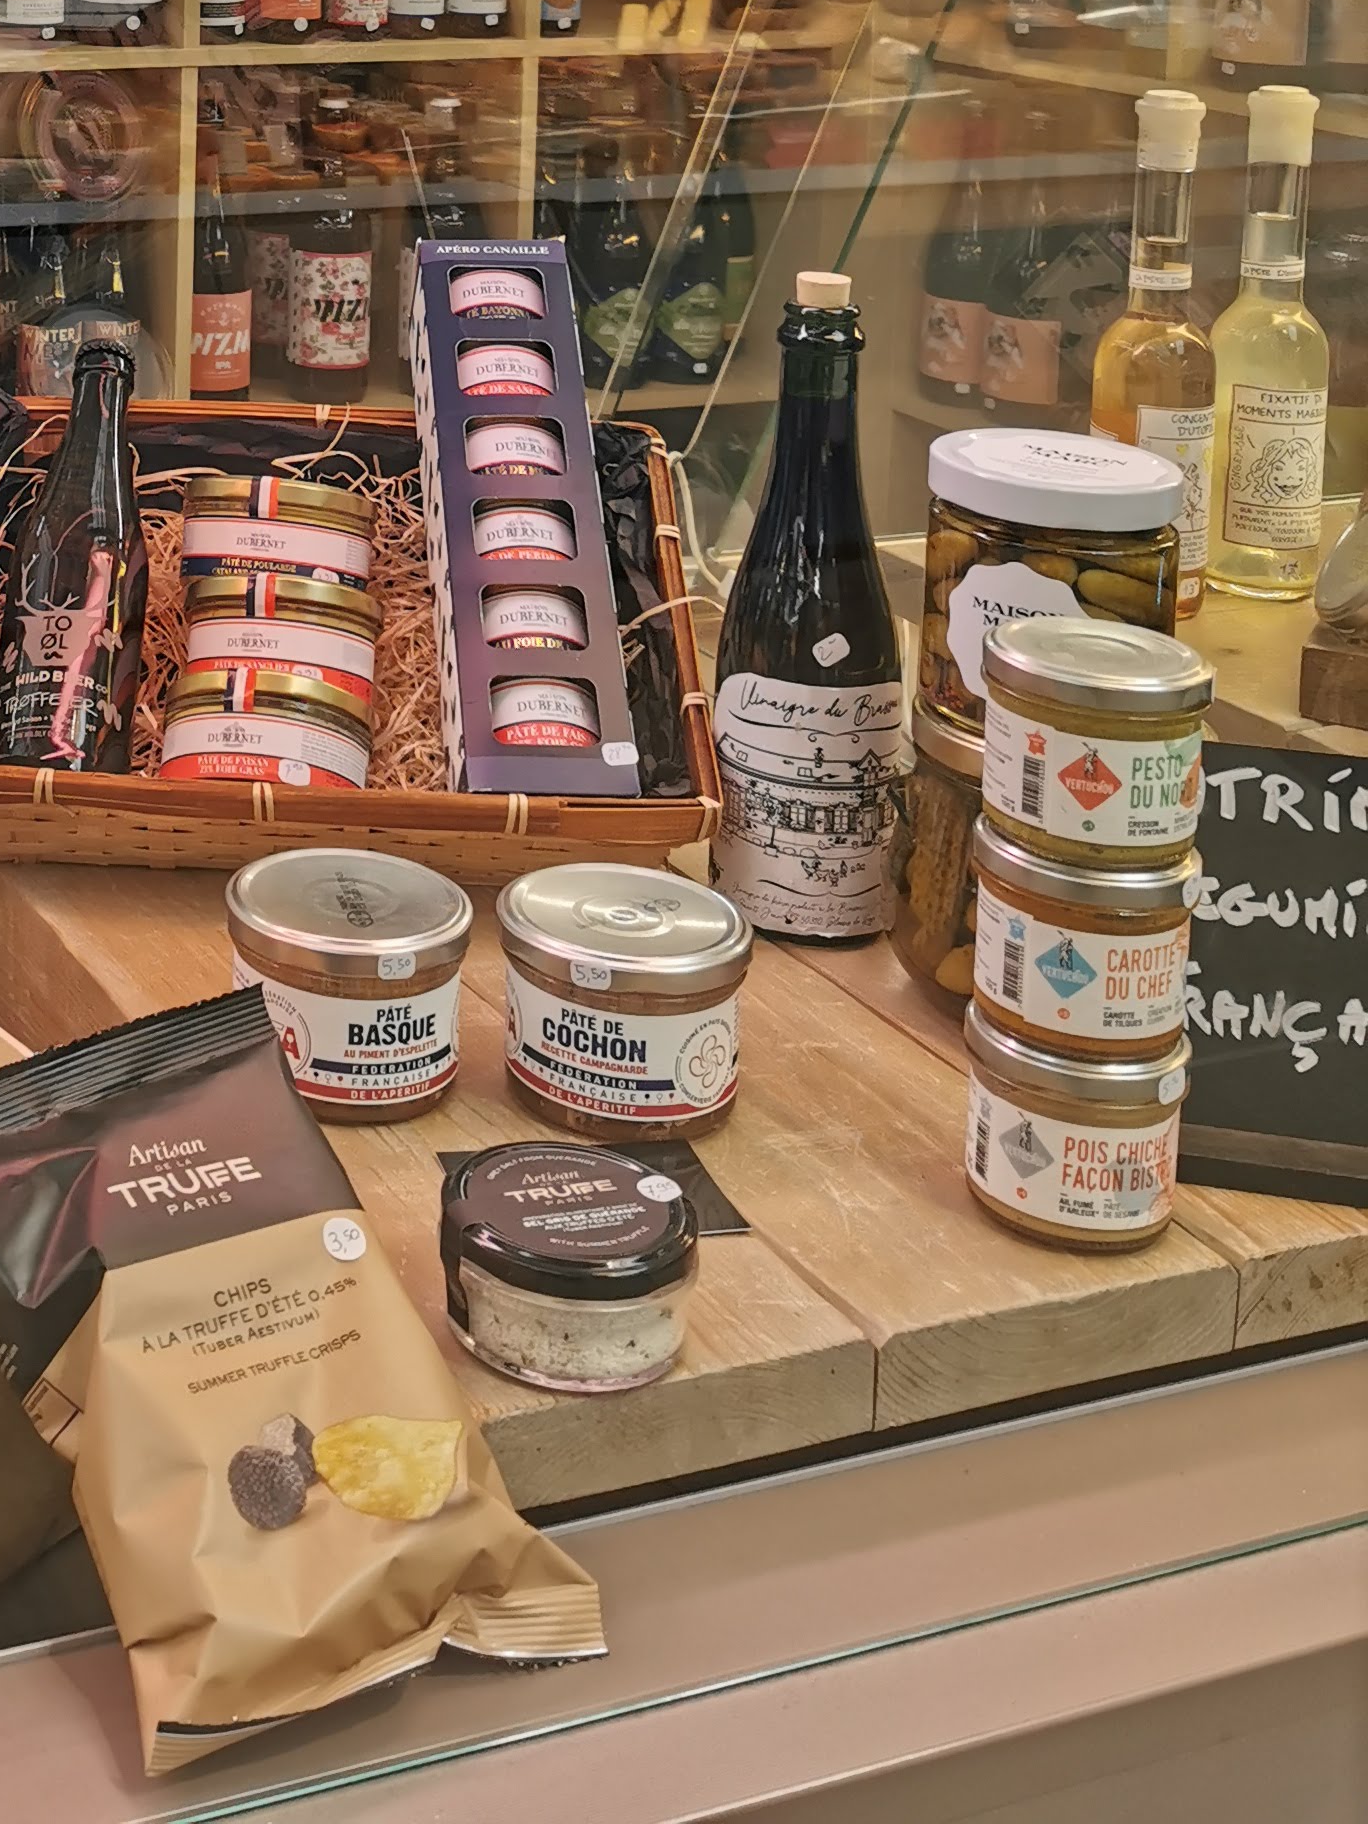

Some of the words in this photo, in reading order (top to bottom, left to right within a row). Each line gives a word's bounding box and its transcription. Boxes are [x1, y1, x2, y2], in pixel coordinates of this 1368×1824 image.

[436, 245, 481, 254] APÉRO
[483, 245, 550, 255] CANAILLE
[463, 285, 526, 299] DUBERNET
[24, 327, 75, 342] WINTER
[476, 363, 540, 379] DUBERNET
[1260, 393, 1311, 405] FIXATIF
[1236, 404, 1293, 419] MOMENTS
[1024, 443, 1128, 466] MAISON
[236, 536, 287, 550] DUBERNET
[486, 526, 554, 542] DUBERNET
[240, 559, 252, 568] DE
[972, 595, 1065, 617] MAISO
[43, 615, 72, 632] TO
[499, 611, 569, 627] DUBERNET
[40, 632, 68, 650] ØL
[226, 638, 280, 649] DUBERNET
[513, 637, 545, 649] FOIE
[15, 671, 50, 686] WILD
[516, 700, 587, 720] DUBERNET
[740, 679, 819, 724] Vinaigre
[824, 698, 849, 718] du
[207, 732, 263, 744] DUBERNET
[506, 725, 536, 741] PÂTÉ
[542, 726, 559, 738] DE
[220, 755, 233, 765] DE
[1132, 754, 1182, 781] PESTO
[1129, 785, 1152, 809] DU
[1160, 782, 1186, 808] NO
[1105, 976, 1129, 1000] DU
[1136, 971, 1173, 1000] CHEF
[376, 1003, 412, 1023] PÂTÉ
[561, 1008, 597, 1032] PÂTÉ
[603, 1019, 624, 1036] DE
[348, 1014, 436, 1046] BASQUE
[343, 1050, 356, 1058] AU
[358, 1050, 390, 1059] PIMENT
[393, 1039, 438, 1057] D'ESPELETTE
[542, 1017, 647, 1063] COCHON
[541, 1040, 577, 1063] RECETTE
[579, 1056, 649, 1076] CAMPAGNARDE
[351, 1068, 431, 1087] FRANÇAISE
[351, 1090, 366, 1100] DE
[548, 1085, 563, 1098] DE
[549, 1073, 637, 1103] FRANÇAISE
[127, 1137, 207, 1168] Artisan
[1064, 1136, 1108, 1164] POIS
[1116, 1132, 1168, 1166] CHICHE
[154, 1162, 171, 1172] DE
[176, 1158, 192, 1168] LA
[107, 1156, 262, 1208] TRUFFE
[522, 1170, 581, 1186] Artisan
[1061, 1163, 1124, 1195] FAÇON
[504, 1179, 618, 1203] TRUFFE
[167, 1191, 233, 1216] PARIS
[213, 1278, 272, 1308] CHIPS
[141, 1335, 156, 1354] À
[157, 1331, 182, 1349] LA
[182, 1307, 254, 1341] TRUFFE
[256, 1290, 306, 1319] D'ÉTÉ
[188, 1368, 248, 1394] SUMMER
[247, 1351, 308, 1378] TRUFFLE
[308, 1329, 362, 1361] CRISPS
